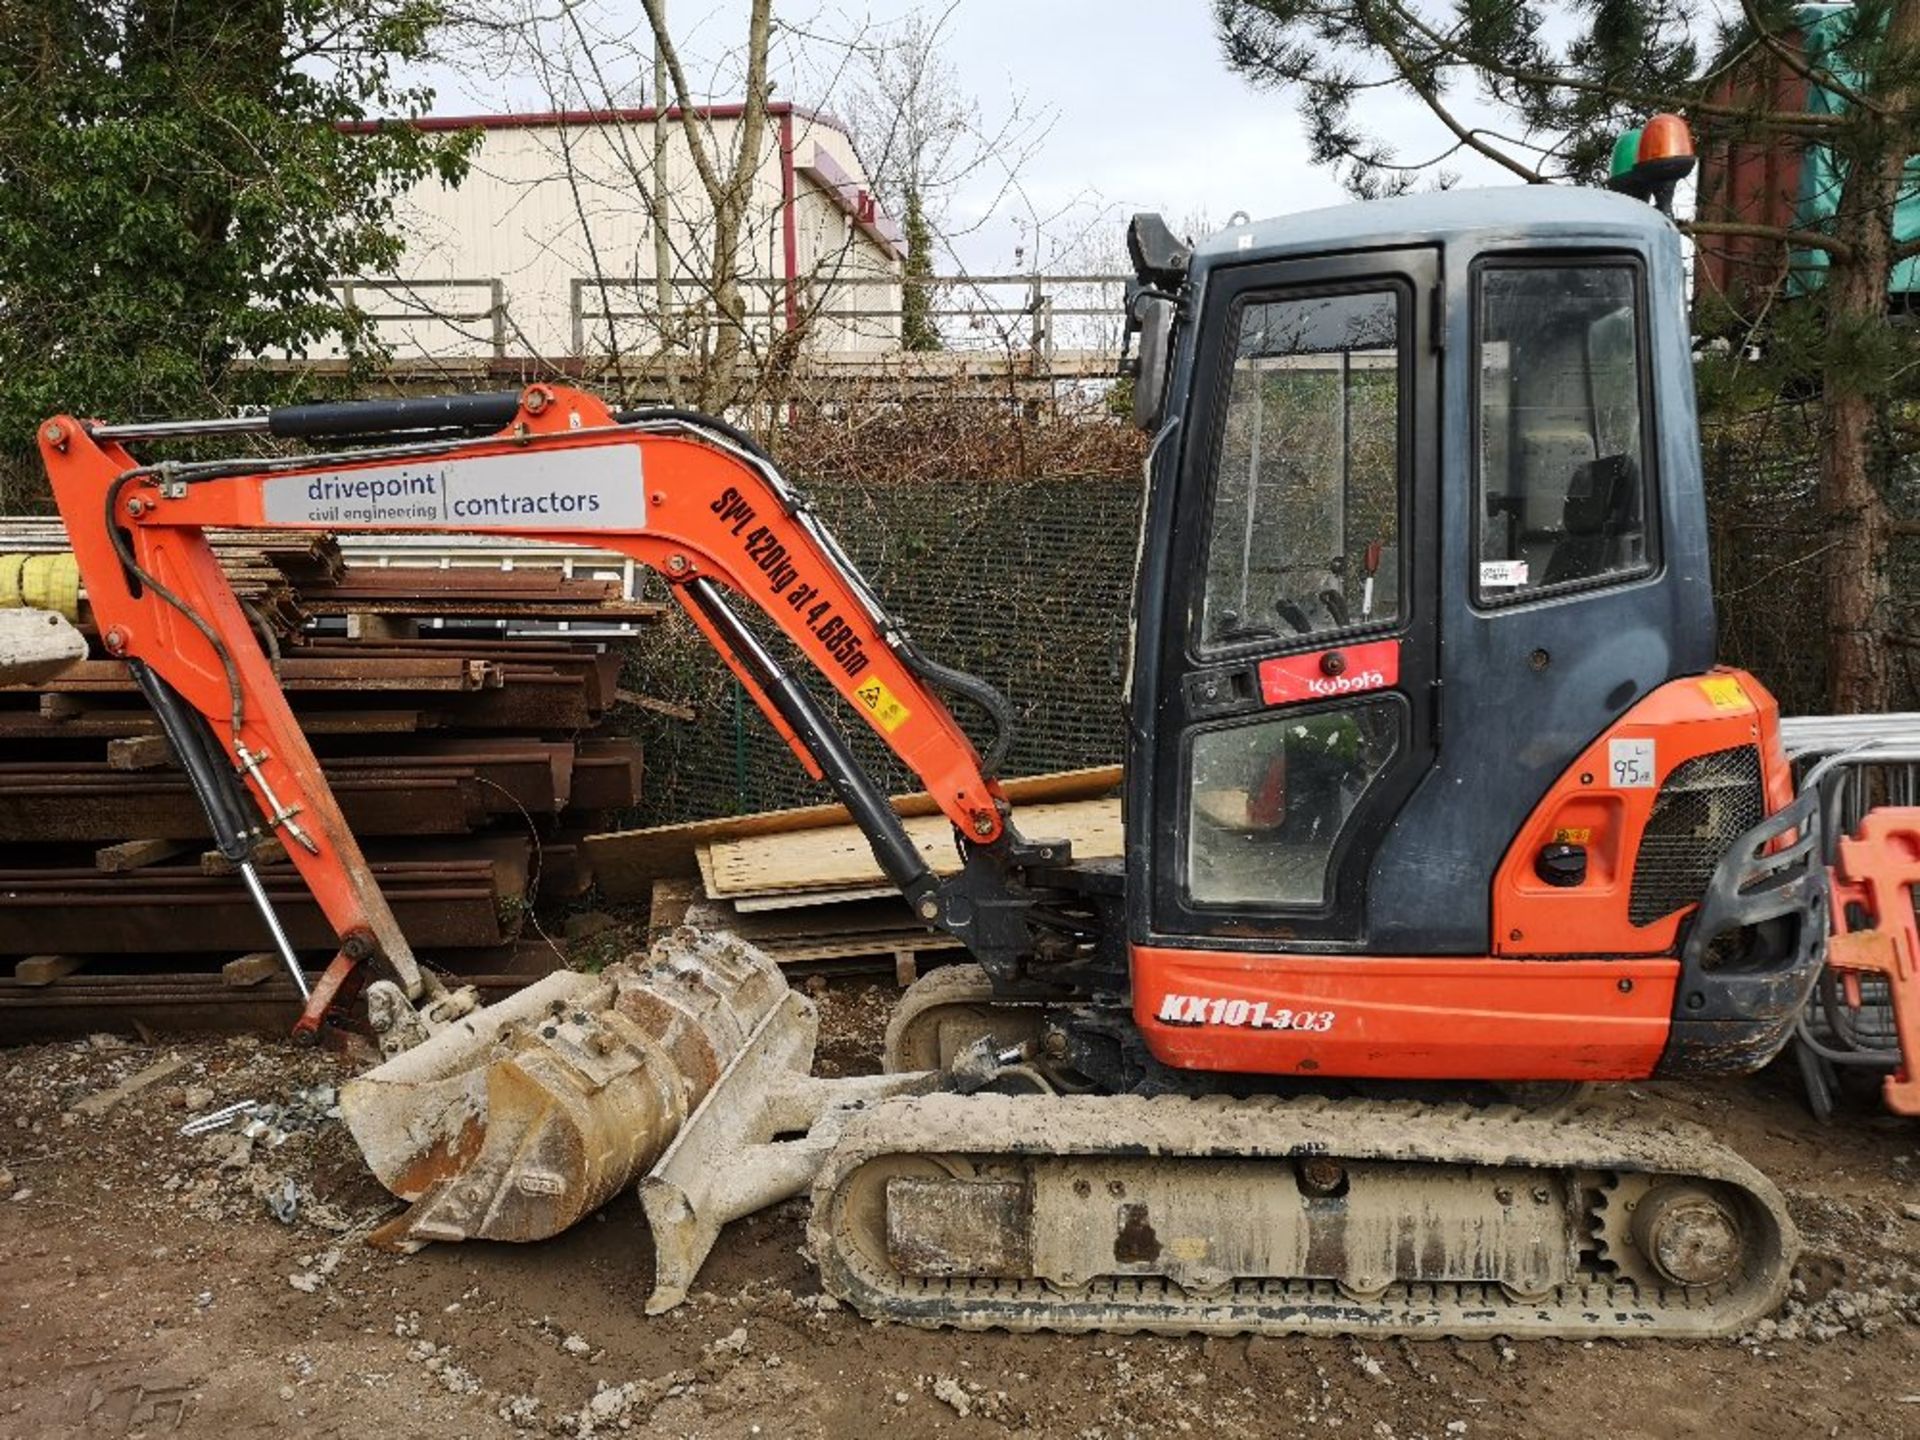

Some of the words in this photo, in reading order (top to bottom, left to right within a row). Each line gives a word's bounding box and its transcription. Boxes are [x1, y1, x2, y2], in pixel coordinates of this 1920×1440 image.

[308, 472, 437, 503] drivepoint
[308, 506, 339, 521] civil
[343, 503, 437, 523] engineering
[454, 491, 600, 517] contractors
[710, 487, 757, 537] SWL
[744, 525, 800, 595] 420kg
[786, 583, 819, 614] at
[805, 600, 870, 678] 4.685m
[1308, 671, 1384, 695] Kubota
[1614, 759, 1639, 784] 95
